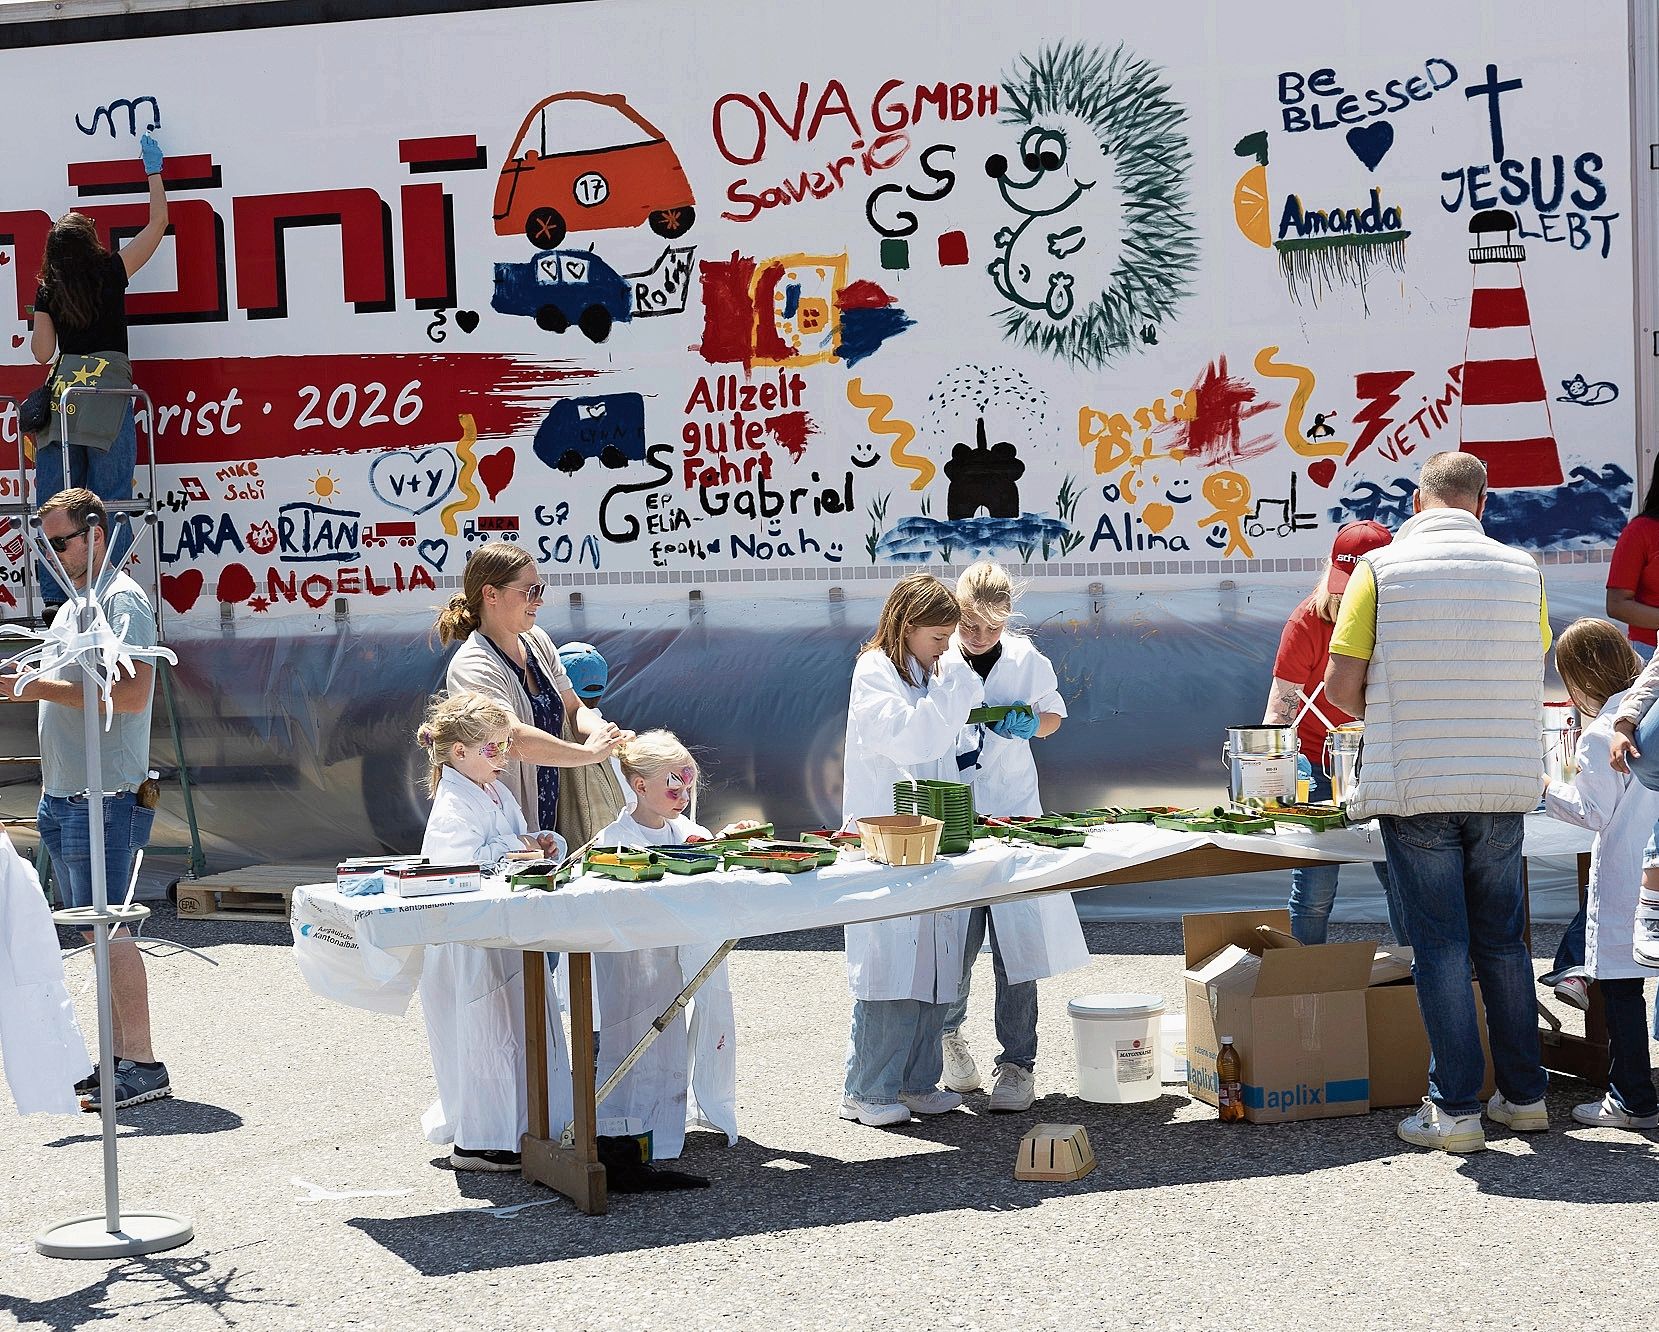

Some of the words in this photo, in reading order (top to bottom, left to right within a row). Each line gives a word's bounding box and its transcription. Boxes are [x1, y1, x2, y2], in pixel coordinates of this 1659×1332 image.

[713, 79, 862, 165] OVA
[872, 79, 998, 133] GMBH
[580, 179, 604, 202] 17
[1440, 152, 1608, 213] JESUS
[1278, 186, 1403, 239] Amanda
[1515, 210, 1620, 259] LEBT
[294, 380, 424, 431] 2026
[684, 367, 806, 414] Allzeit
[683, 411, 766, 457] gute
[683, 451, 773, 490] Fahrt
[700, 471, 854, 520] Gabriel
[158, 513, 245, 562] LARA
[731, 528, 822, 560] Noah
[1090, 513, 1191, 553] Alina
[267, 562, 436, 608] NOELIA
[181, 900, 198, 911] EPAL
[1267, 1084, 1323, 1115] aplix
